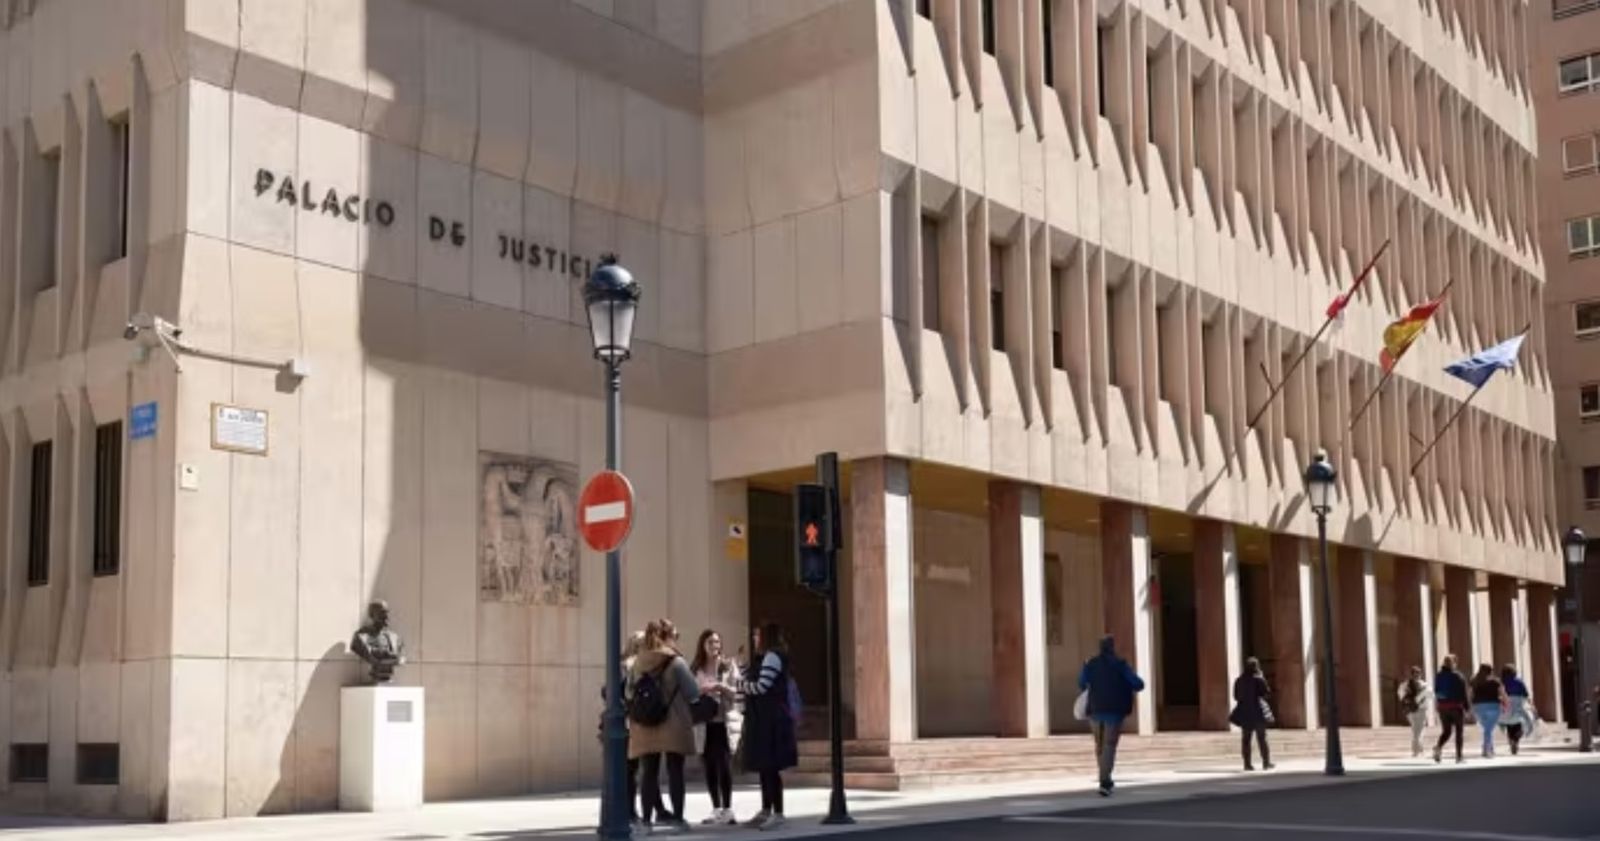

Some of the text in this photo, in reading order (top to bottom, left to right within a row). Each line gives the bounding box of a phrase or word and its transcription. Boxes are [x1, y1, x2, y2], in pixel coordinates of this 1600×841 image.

[254, 168, 598, 280] PALACIO DE JUSTICI
